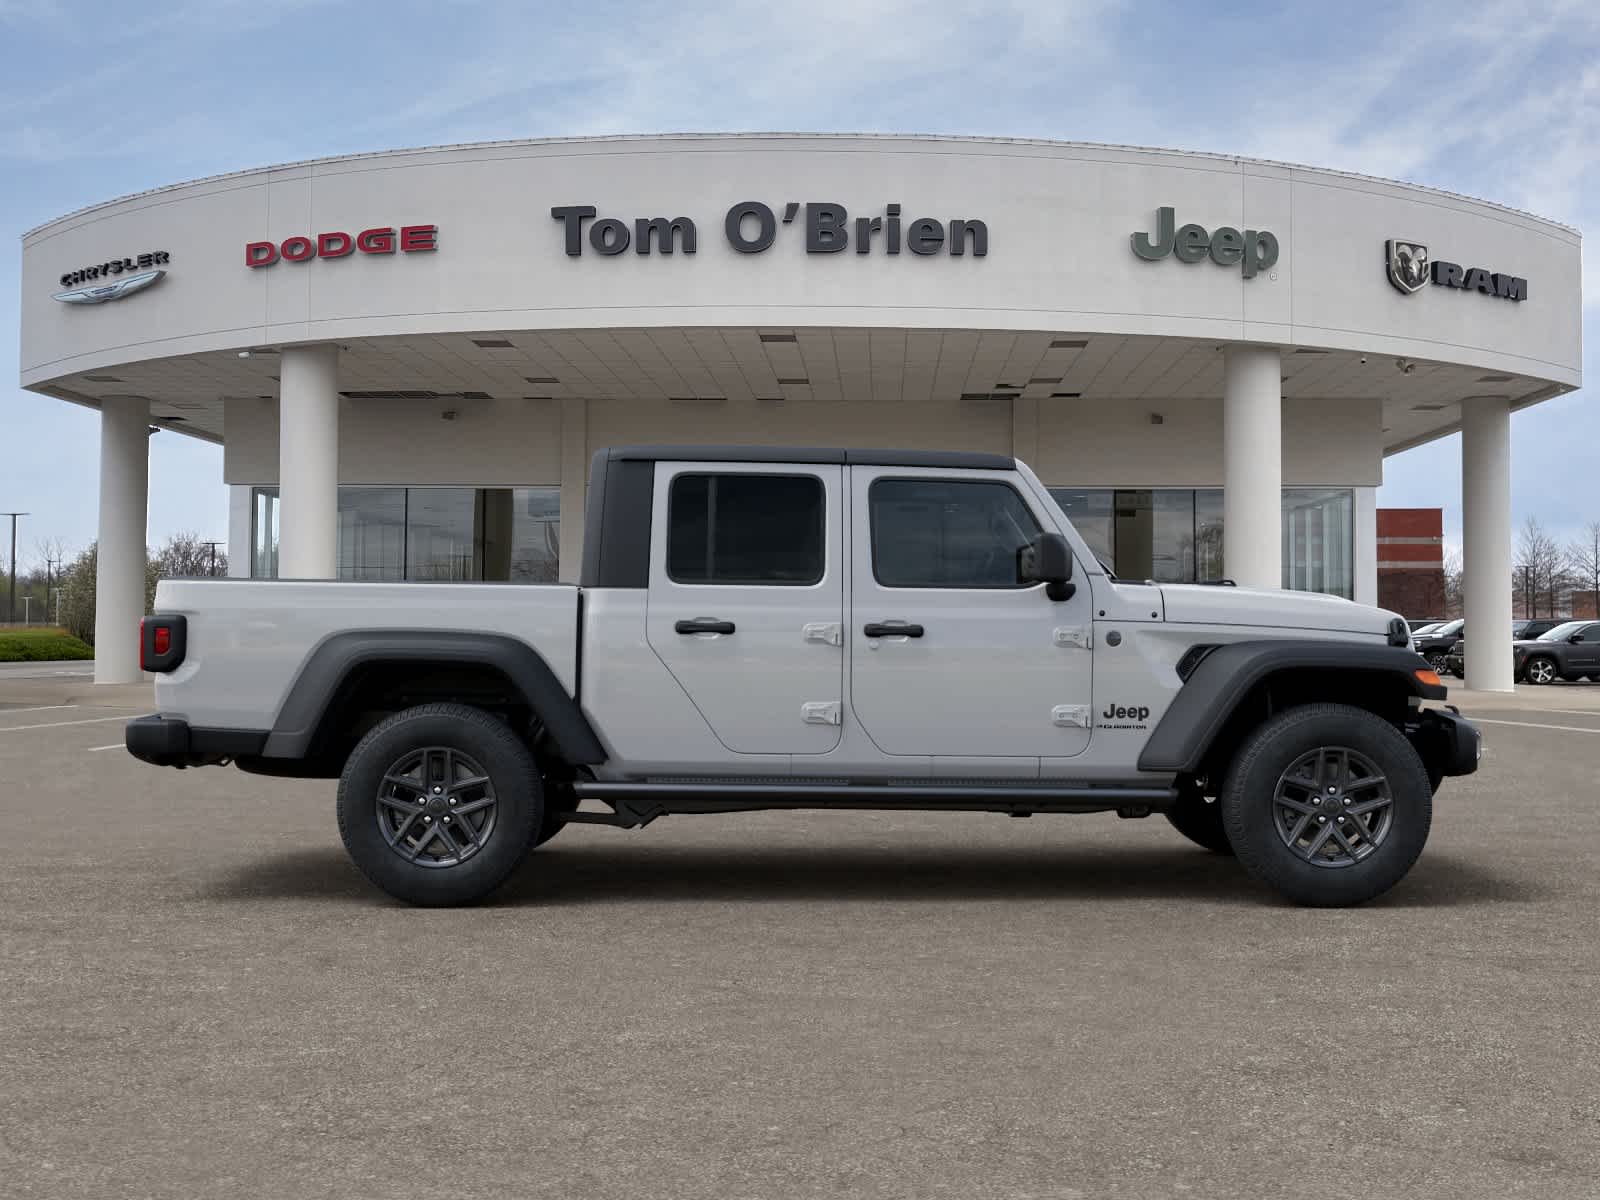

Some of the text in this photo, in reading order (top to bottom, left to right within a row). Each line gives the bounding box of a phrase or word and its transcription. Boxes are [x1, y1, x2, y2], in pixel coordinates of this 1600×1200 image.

[245, 224, 437, 268] DODGE
[551, 201, 988, 257] Tom O'Brien
[1130, 207, 1280, 279] Jeep
[60, 250, 170, 287] CHRYSLER
[1430, 260, 1528, 302] RAM
[1103, 704, 1149, 721] Jeep
